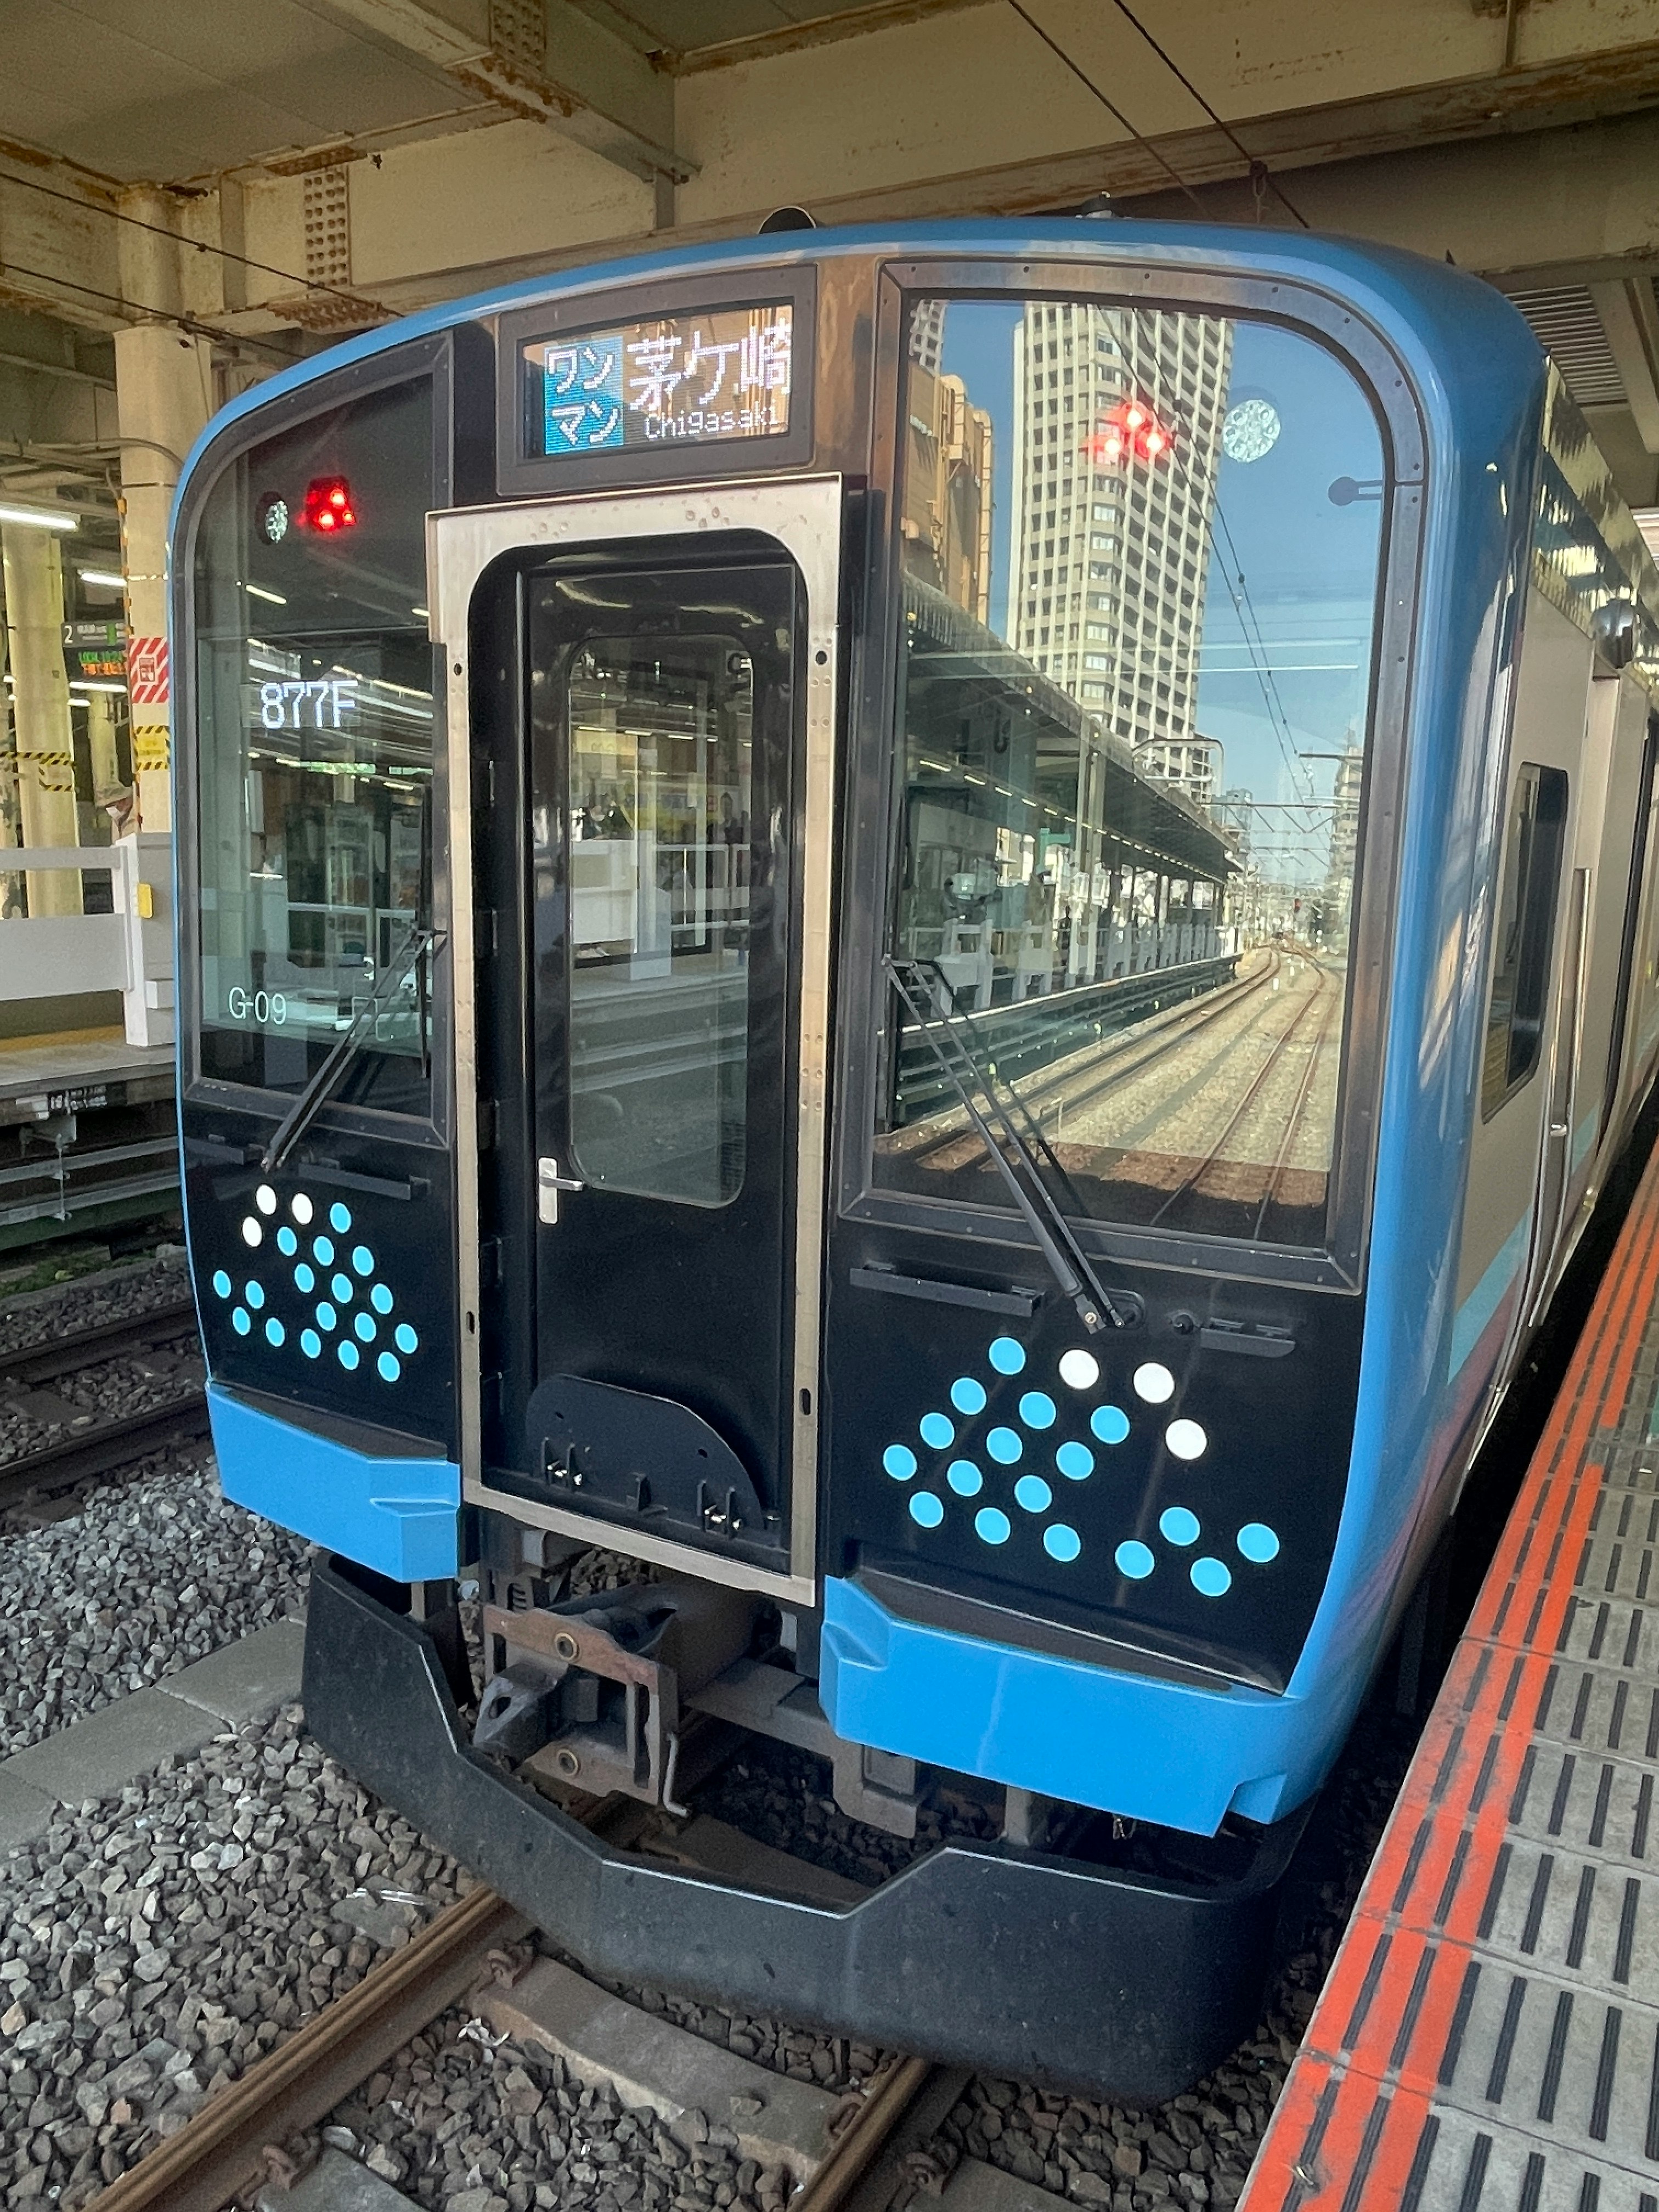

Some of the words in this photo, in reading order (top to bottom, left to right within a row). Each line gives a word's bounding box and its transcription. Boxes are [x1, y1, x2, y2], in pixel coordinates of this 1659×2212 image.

[548, 347, 613, 393] ワン
[552, 400, 619, 445] マン
[645, 399, 779, 439] Chigasaki
[64, 624, 74, 644] 2
[260, 680, 359, 729] 877F
[228, 986, 287, 1025] G-09
